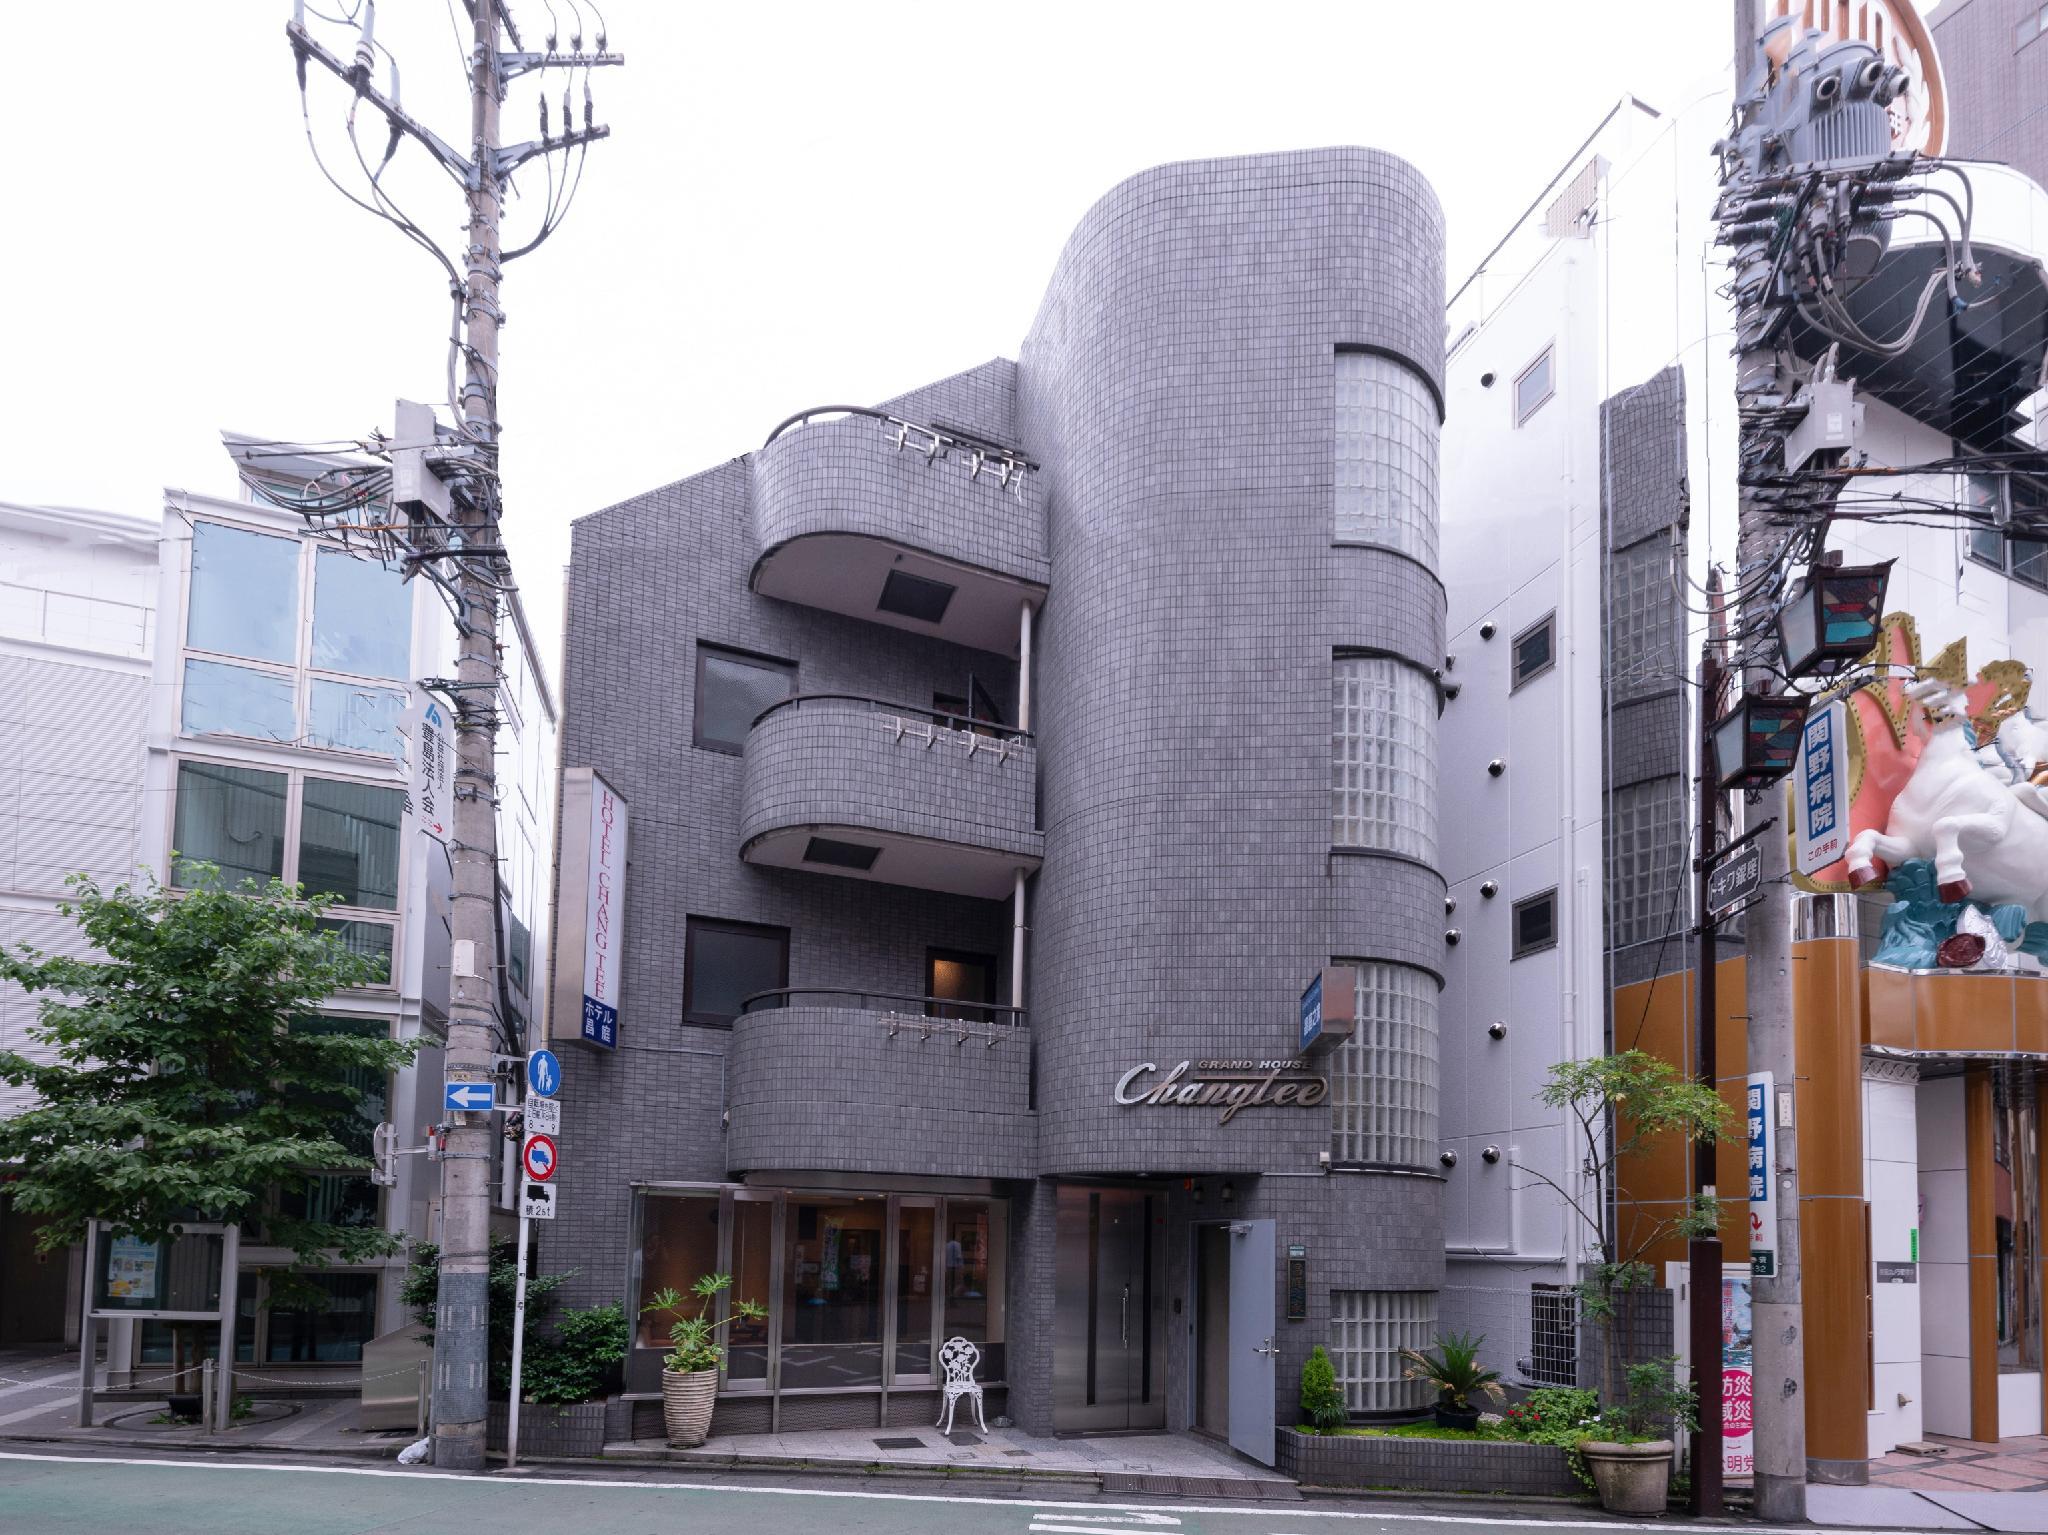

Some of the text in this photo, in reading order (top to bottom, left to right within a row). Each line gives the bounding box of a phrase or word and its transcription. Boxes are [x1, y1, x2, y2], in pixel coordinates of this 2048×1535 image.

[1807, 714, 1834, 835] 関野病院
[1807, 838, 1838, 862] この手前
[593, 790, 614, 1001] HOTEL CHANG TEE
[585, 1000, 613, 1024] ホテル
[1198, 1060, 1312, 1069] GRAND HOUSE
[1722, 1455, 1754, 1473] 明党
